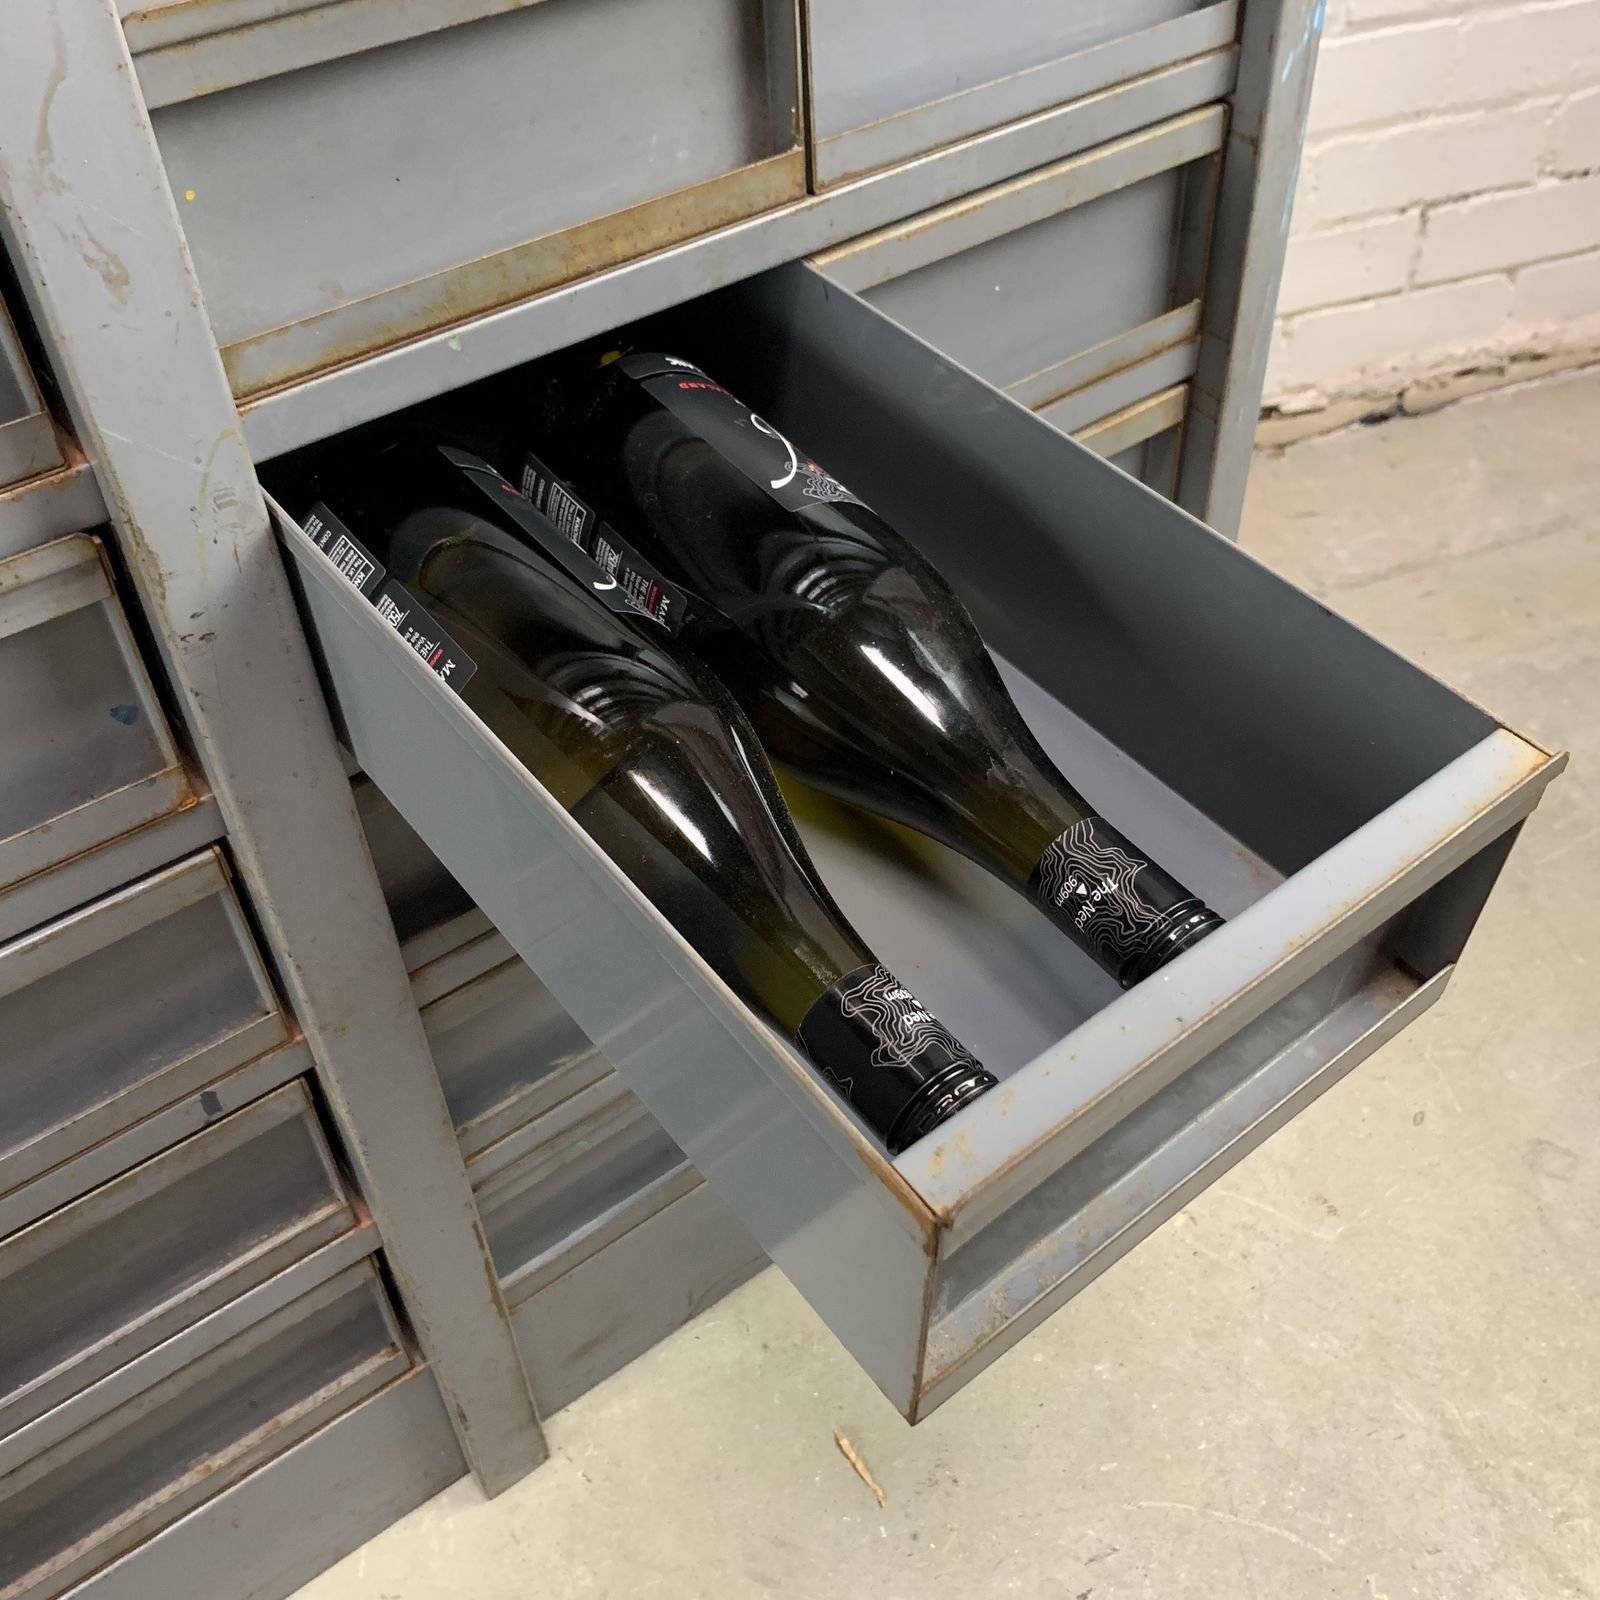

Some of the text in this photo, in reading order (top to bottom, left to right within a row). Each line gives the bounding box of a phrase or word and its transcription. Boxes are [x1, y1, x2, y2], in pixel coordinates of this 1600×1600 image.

[353, 572, 365, 587] KN
[420, 641, 434, 658] THE
[1055, 875, 1078, 907] 909m
[1074, 877, 1119, 933] The Ned
[903, 1010, 931, 1030] Ned
